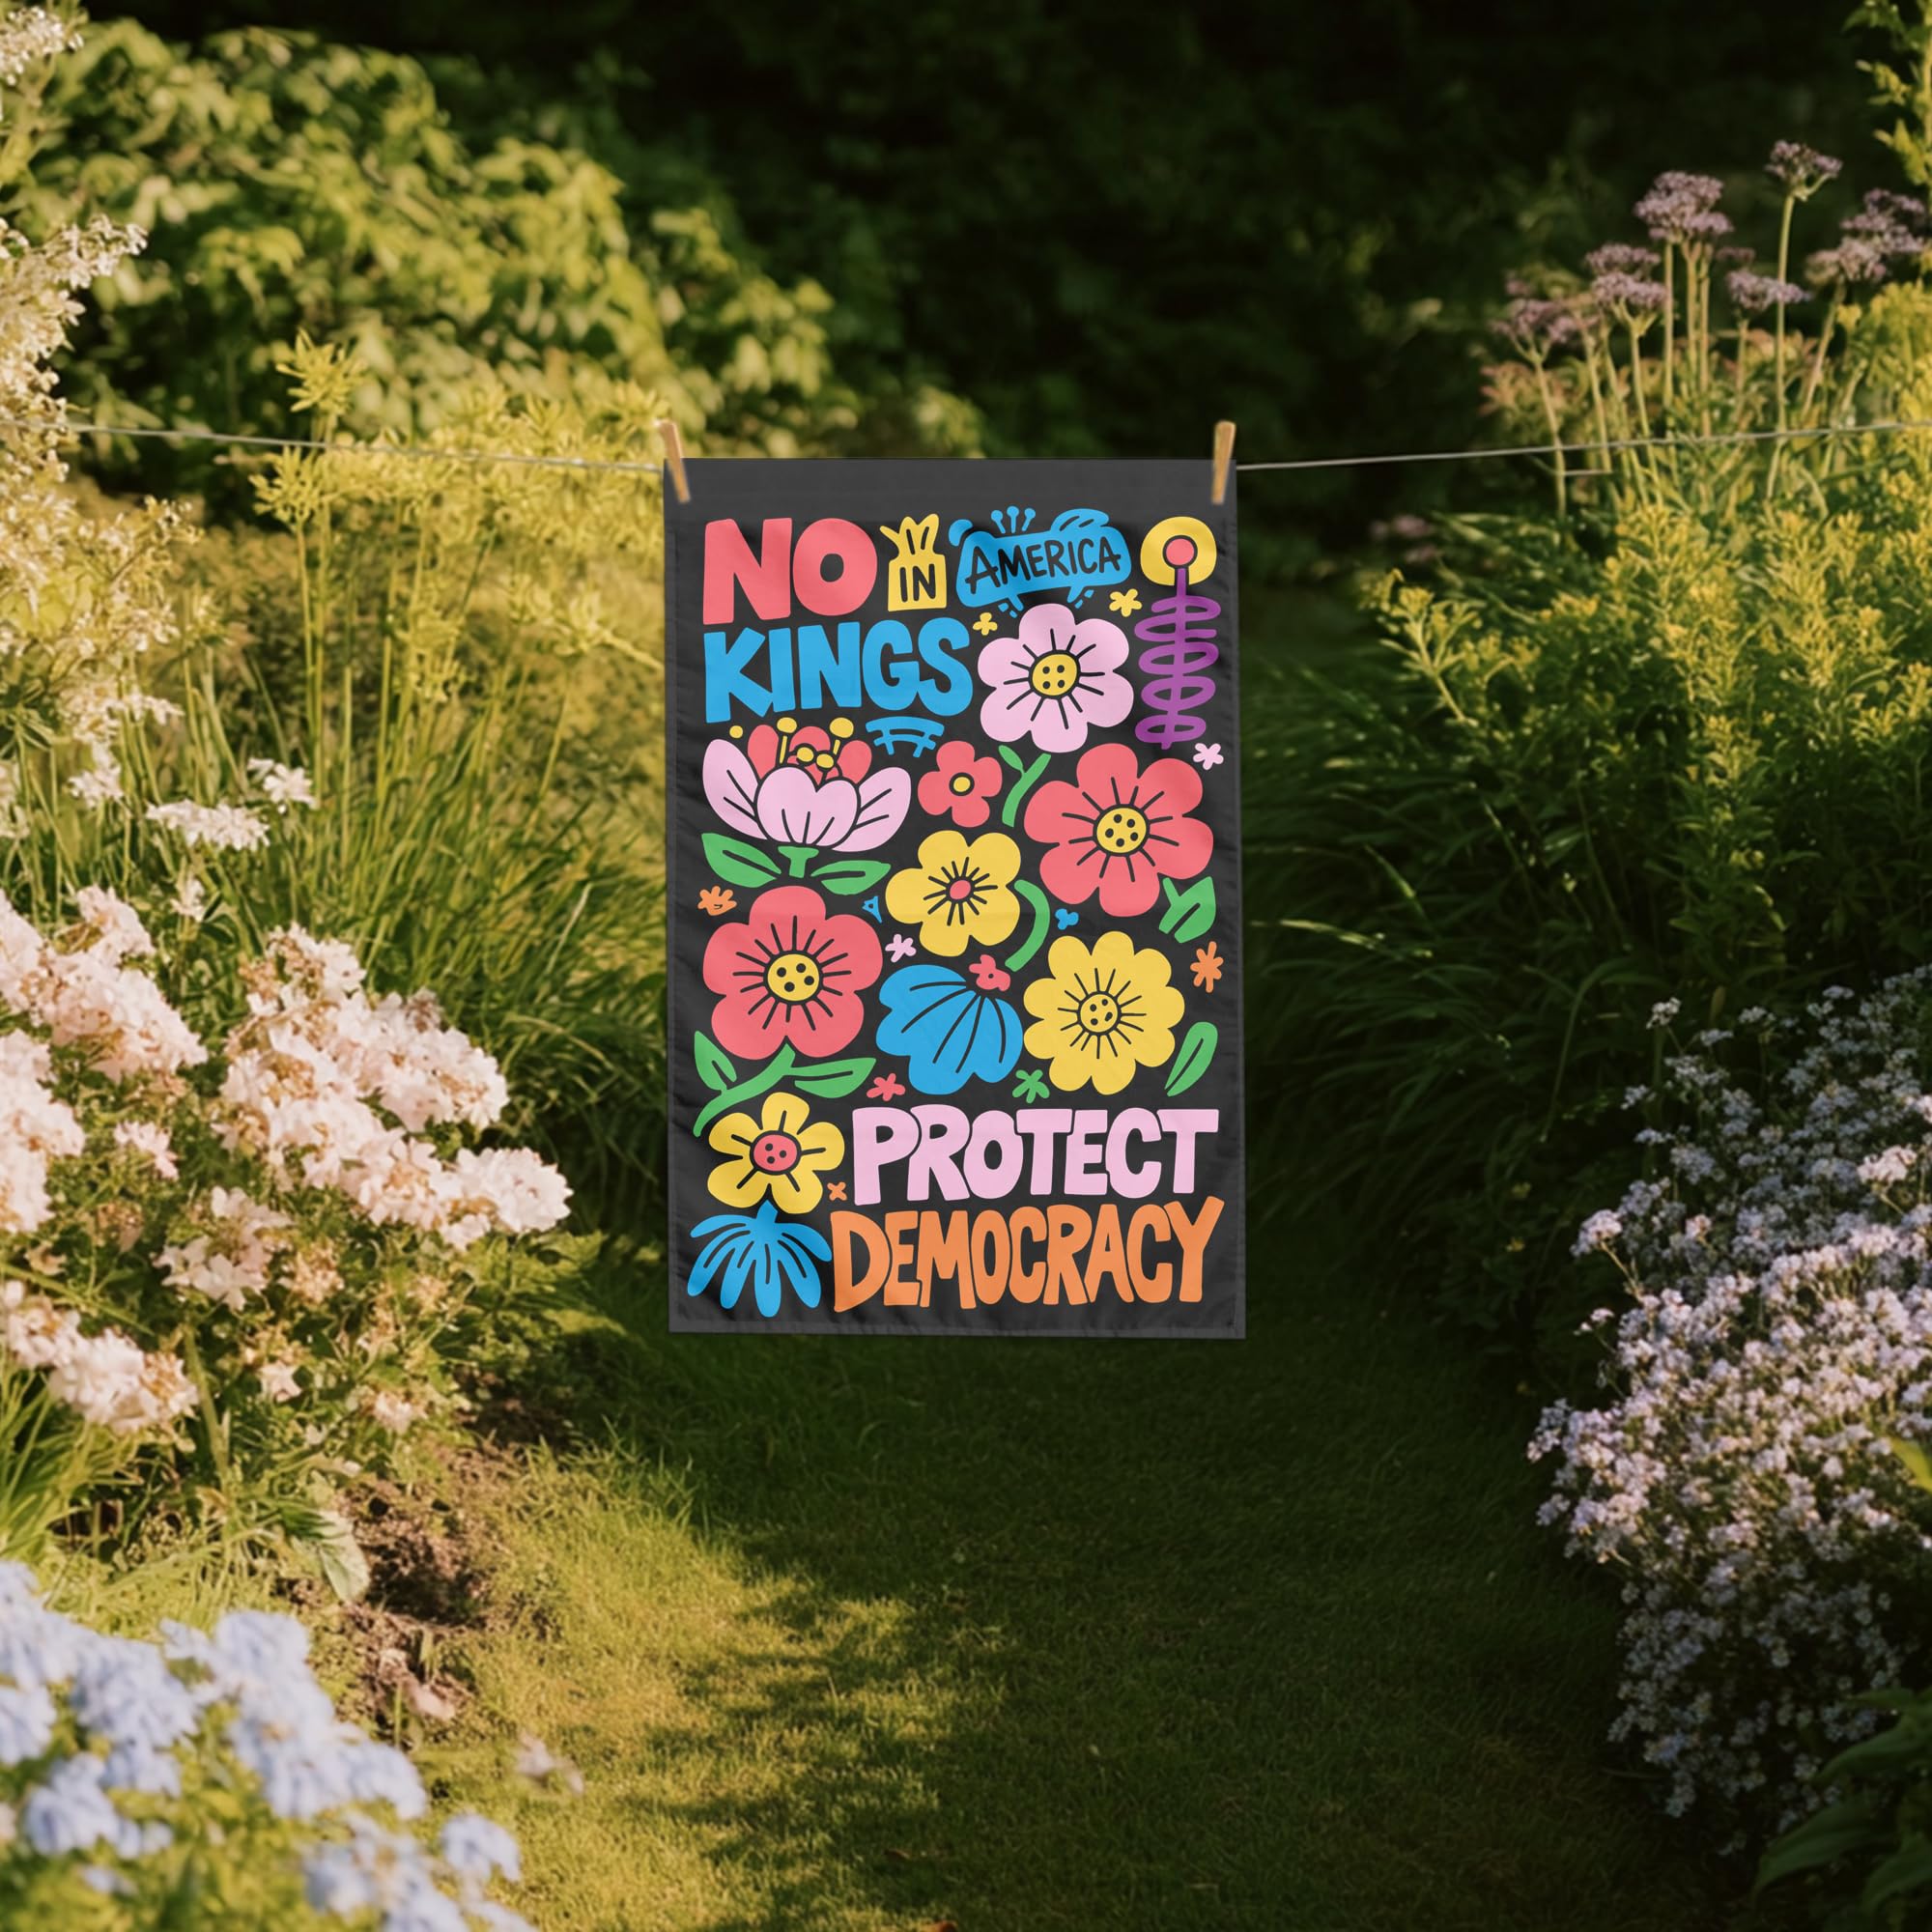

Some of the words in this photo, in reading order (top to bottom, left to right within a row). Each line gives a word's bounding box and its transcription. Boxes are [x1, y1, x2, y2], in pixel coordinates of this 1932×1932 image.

[702, 518, 877, 625] NO
[898, 563, 937, 603] IN
[963, 536, 1122, 594] AMERICA
[704, 616, 974, 724] KINGS
[852, 1104, 1219, 1206] PROTECT
[830, 1196, 1225, 1313] DEMOCRACY
